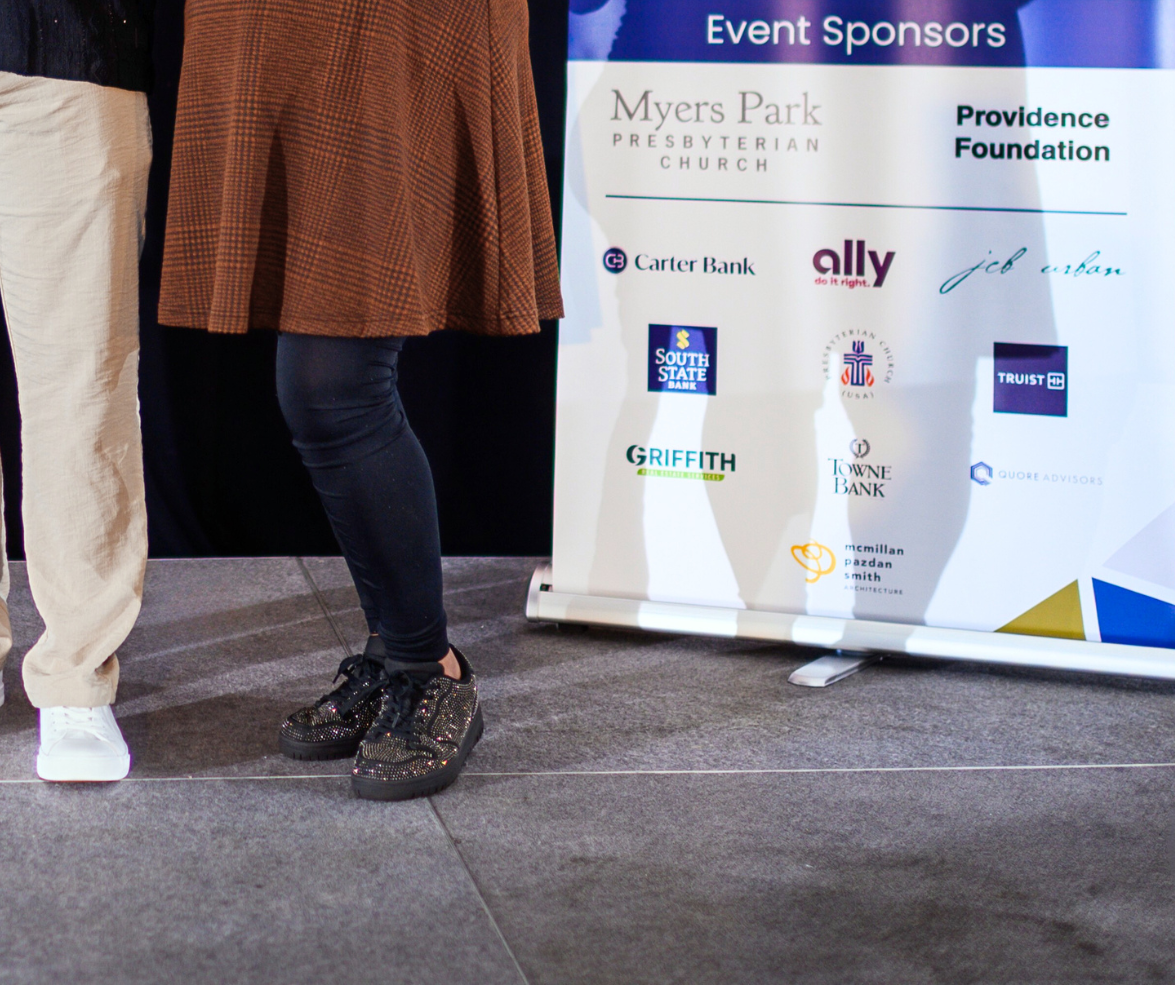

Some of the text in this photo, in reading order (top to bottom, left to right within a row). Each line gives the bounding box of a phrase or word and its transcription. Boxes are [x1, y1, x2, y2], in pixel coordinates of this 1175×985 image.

[707, 13, 1007, 55] Event Sponsors
[610, 88, 823, 131] Myers Park
[956, 104, 1110, 130] Providence
[612, 132, 820, 153] PRESBYTERIAN
[955, 137, 1110, 163] Foundation
[659, 155, 768, 172] CHURCH
[634, 253, 756, 276] Carter Bank
[812, 239, 896, 288] ally
[939, 247, 1125, 294] jcb urban
[814, 275, 870, 290] do it right.
[822, 329, 895, 384] PRESBYTERIAN CHURCH
[667, 381, 697, 391] BANK
[997, 372, 1045, 385] TRUIST
[841, 390, 875, 400] (USA)
[626, 444, 736, 472] GRIFFITH
[998, 470, 1103, 485] QUORE ADVISORS
[845, 544, 904, 555] mcmillan
[845, 557, 892, 568] pazdan
[845, 572, 881, 582] smith
